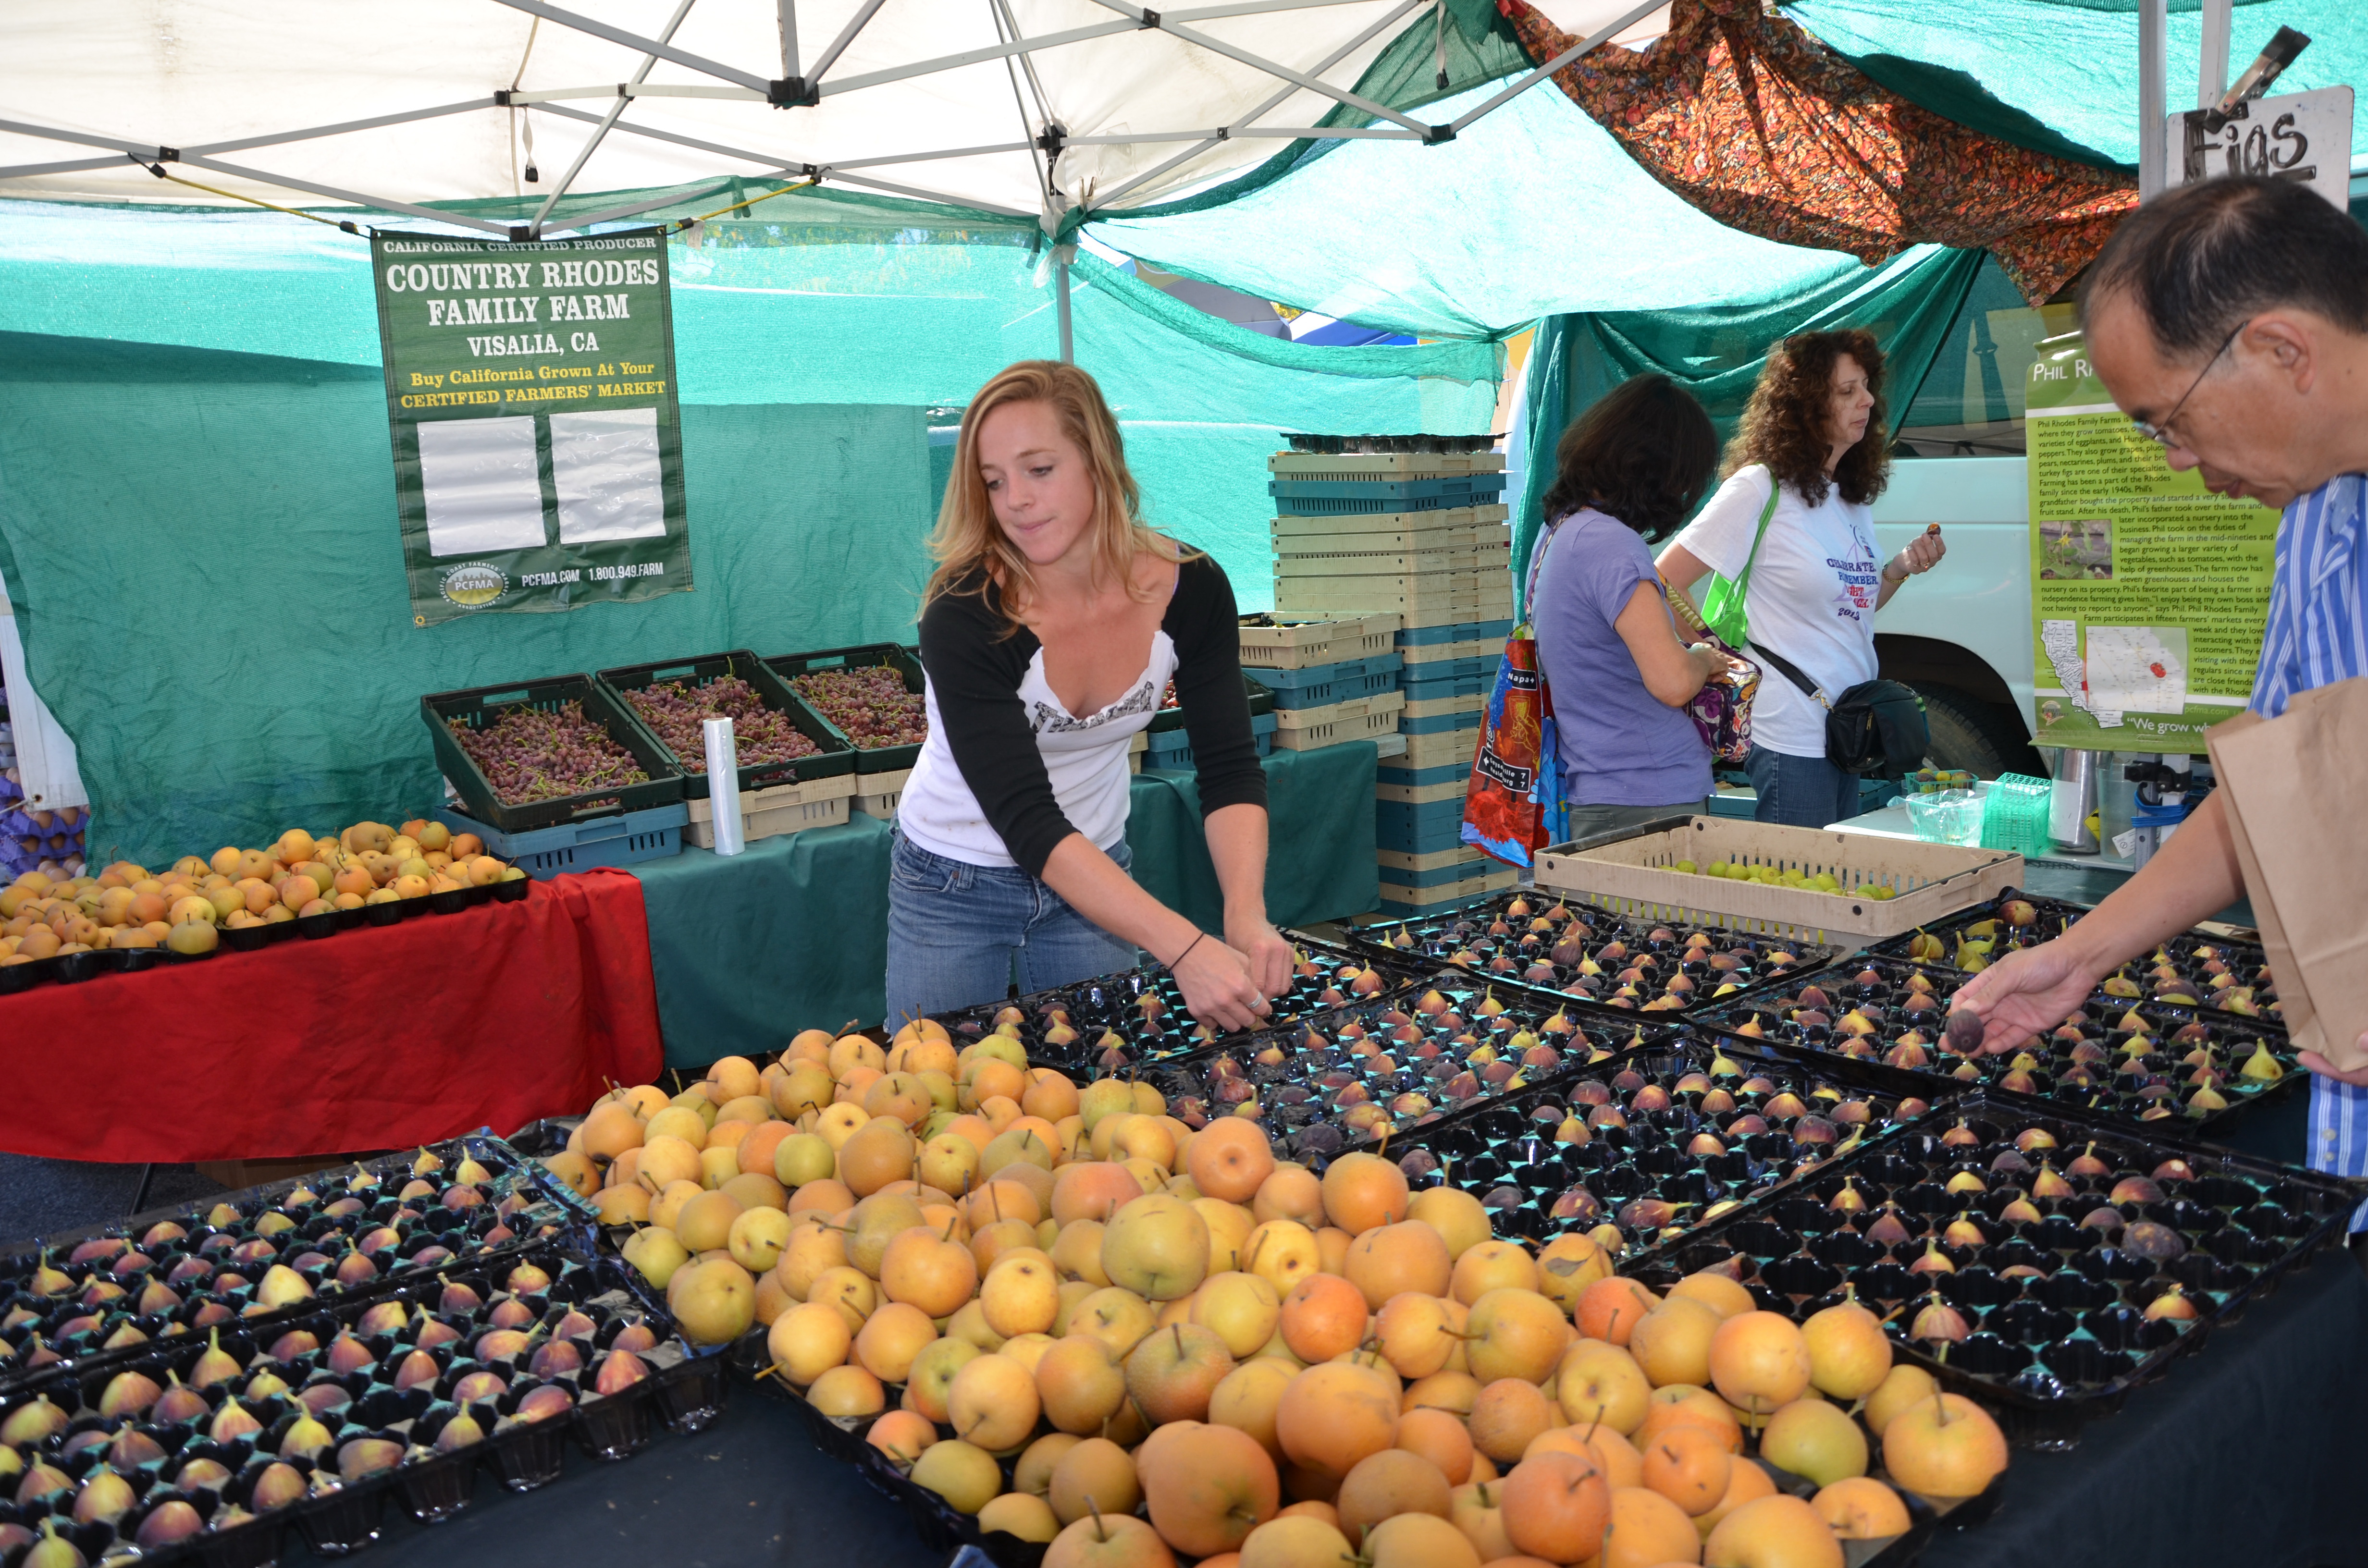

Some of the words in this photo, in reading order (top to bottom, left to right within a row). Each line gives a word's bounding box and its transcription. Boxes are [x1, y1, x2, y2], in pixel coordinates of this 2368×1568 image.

[384, 241, 483, 253] CALIFORNIA
[487, 241, 570, 252] CERTIFIED
[575, 237, 656, 251] PRODUCER
[387, 263, 531, 292] COUNTRY
[541, 259, 659, 288] RHODES
[427, 296, 540, 326] FAMILY
[549, 294, 630, 321] FARM
[467, 334, 564, 356] VISALIA,
[571, 332, 599, 352] CA
[410, 372, 443, 388] Buy
[450, 367, 534, 384] California
[539, 365, 592, 379] Grown
[597, 363, 614, 376] At
[619, 362, 654, 375] Your
[401, 392, 500, 408] CERTIFIED
[506, 386, 592, 402] FARMERS'
[598, 381, 665, 397] MARKET
[2052, 418, 2075, 427] Rhodes
[2078, 417, 2098, 428] Family
[2100, 416, 2121, 424] Farms
[2038, 429, 2059, 437] where
[2060, 428, 2074, 438] they
[2076, 429, 2093, 437] grow
[2095, 426, 2129, 435] tomatoes,
[2075, 437, 2108, 447] eggplants,
[2038, 450, 2067, 459] peppers.
[2066, 448, 2083, 457] They
[2100, 448, 2117, 456] grow
[2119, 446, 2145, 455] grapes,
[2038, 461, 2059, 469] pears,
[2060, 458, 2095, 467] nectarines,
[2096, 456, 2118, 466] plums,
[2133, 454, 2152, 462] their
[2039, 469, 2060, 478] turkey
[2062, 468, 2072, 478] figs
[2130, 464, 2168, 475] specialties.
[2039, 478, 2066, 488] Farming
[2104, 477, 2119, 486] part
[2144, 474, 2171, 482] Rhodes
[2039, 488, 2059, 498] family
[2092, 487, 2109, 496] early
[2039, 498, 2078, 508] grandfather
[2080, 497, 2103, 507] bought
[2118, 496, 2150, 505] property
[2167, 493, 2194, 502] started
[2109, 506, 2131, 514] death,
[2137, 514, 2184, 525] incorporated
[2120, 536, 2152, 545] managing
[2119, 546, 2139, 555] began
[2141, 546, 2170, 554] growing
[2179, 545, 2200, 554] larger
[2202, 545, 2228, 554] variety
[2120, 555, 2158, 564] vegetables,
[522, 569, 580, 587] PCFMA.COM
[589, 563, 663, 581] 1.800.949.FARM
[2120, 565, 2135, 574] help
[2146, 565, 2195, 574] greenhouses.
[439, 577, 450, 602] PACIFIC
[446, 563, 466, 576] COAST
[469, 562, 501, 572] FARMERS'
[500, 572, 509, 596] MARKET
[455, 579, 494, 590] PCFMA
[2144, 576, 2190, 584] greenhouses
[2089, 586, 2121, 595] property.
[2171, 587, 2186, 595] part
[2198, 586, 2219, 595] being
[458, 600, 496, 610] ASSOCIATION
[2042, 595, 2088, 604] independence
[2089, 595, 2116, 604] farming
[2117, 596, 2134, 604] gives
[2160, 596, 2180, 605] enjoy
[2182, 596, 2202, 605] being
[1838, 608, 1860, 621] 2013
[2056, 605, 2077, 614] having
[2088, 606, 2111, 614] report
[2123, 605, 2154, 614] anyone,"
[2234, 606, 2258, 615] Family
[2103, 615, 2144, 624] participates
[2230, 626, 2246, 636] they
[2193, 637, 2232, 646] interacting
[2235, 647, 2254, 657] They
[2194, 656, 2218, 665] visiting
[2193, 666, 2221, 676] regulars
[1508, 672, 1529, 684] Napa
[2225, 687, 2251, 695] Rhodes
[2184, 705, 2229, 715] pcfma.com
[2158, 723, 2189, 735] grow
[1490, 757, 1515, 777] Geyseille
[1490, 766, 1513, 786] Healdurg
